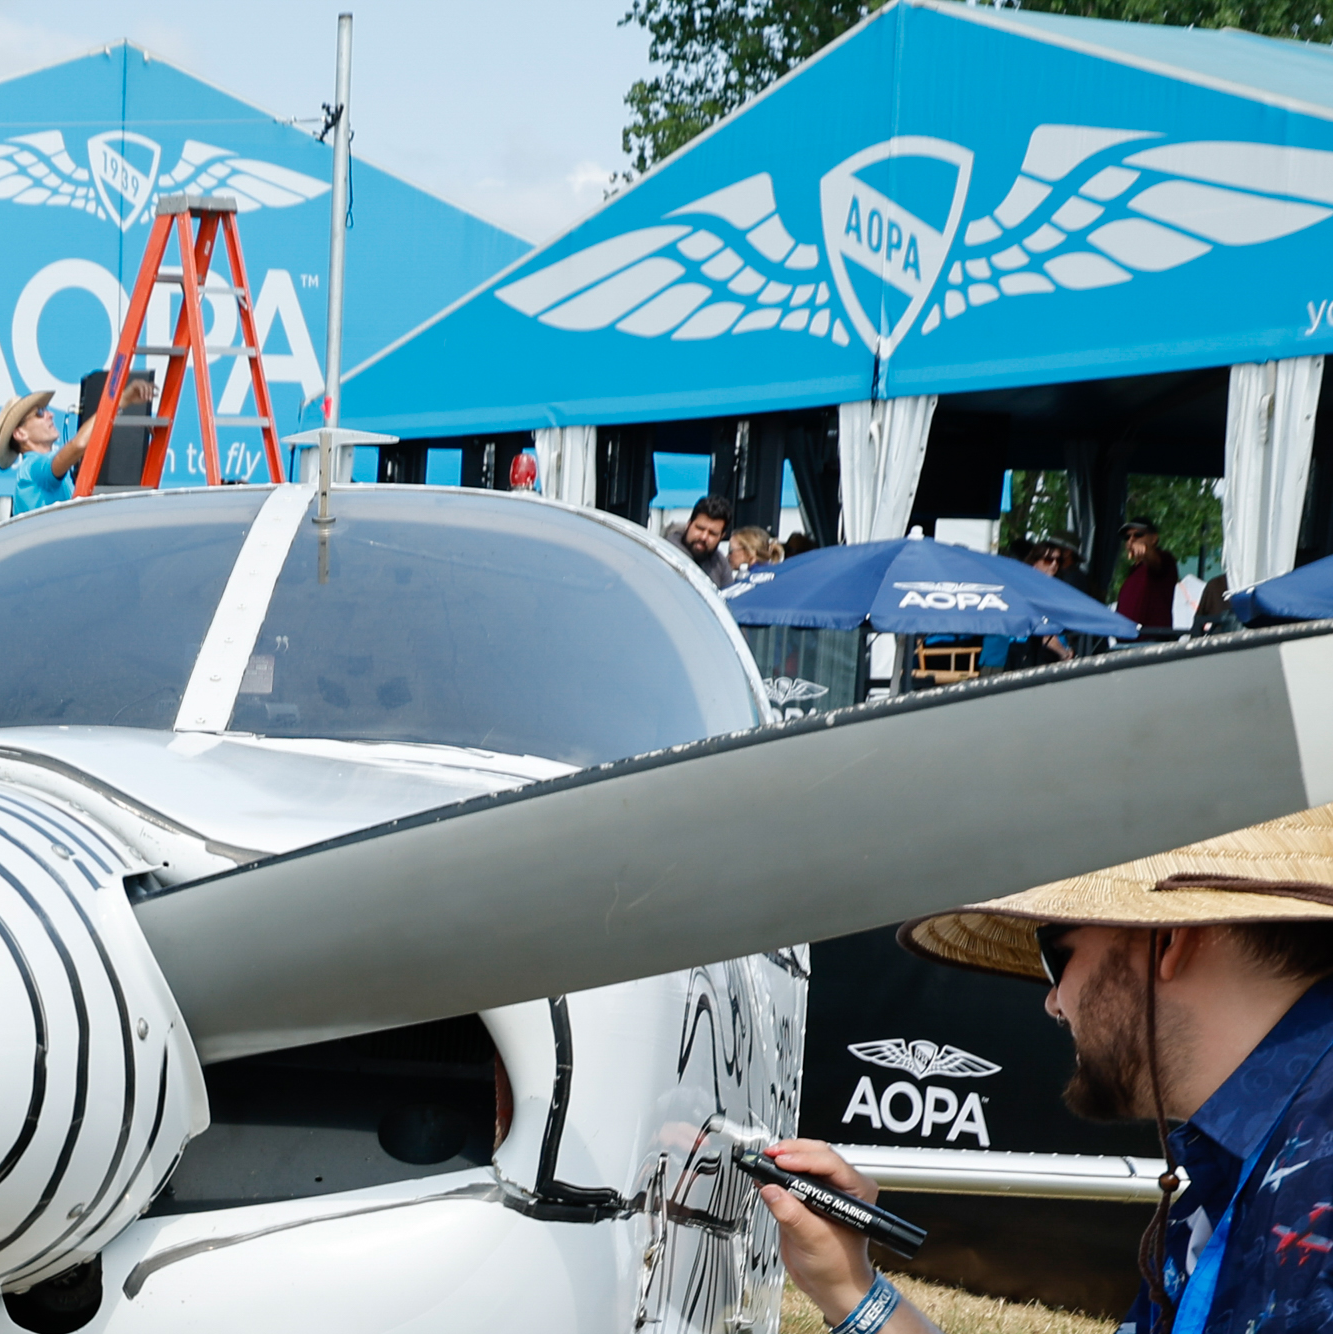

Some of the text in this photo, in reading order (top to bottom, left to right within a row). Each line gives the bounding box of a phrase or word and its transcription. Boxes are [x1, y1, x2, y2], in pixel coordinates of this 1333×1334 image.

[102, 149, 139, 199] 1939
[844, 194, 921, 283] AOPA
[224, 442, 261, 481] fly
[899, 590, 1010, 612] AOPA
[841, 1075, 991, 1147] AOPA
[791, 1179, 834, 1206] ACRYLIC
[832, 1198, 874, 1225] MARKER
